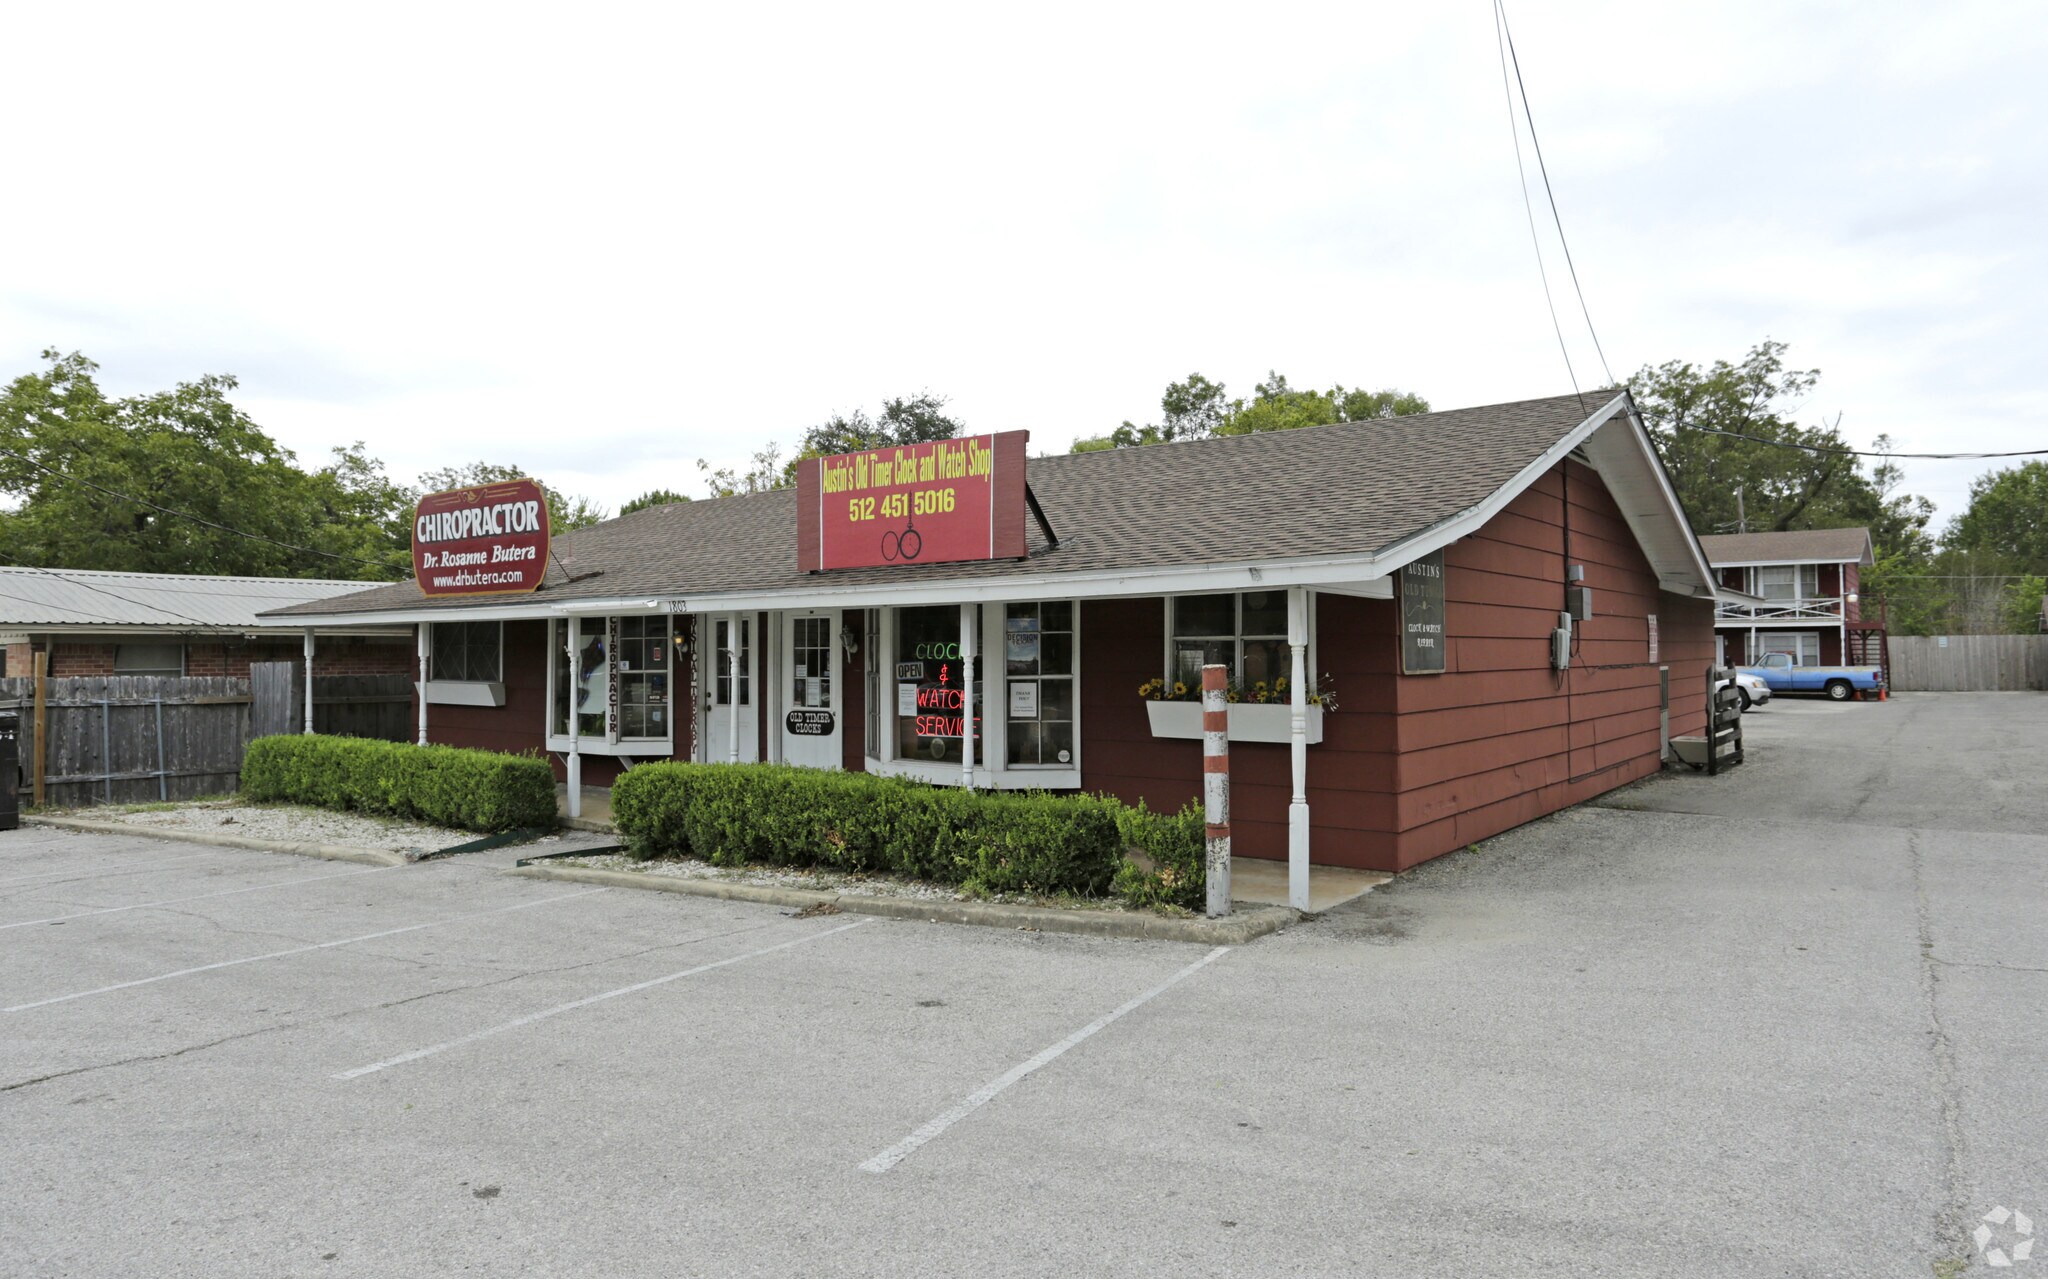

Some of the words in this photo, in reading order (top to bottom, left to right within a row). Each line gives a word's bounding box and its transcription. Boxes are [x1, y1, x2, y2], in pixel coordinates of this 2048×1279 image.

[823, 456, 854, 494] Austin's
[855, 454, 869, 490] Old
[870, 453, 893, 488] Timer
[894, 447, 918, 486] Clock
[920, 444, 936, 482] and
[937, 441, 967, 480] Watch
[968, 438, 991, 483] Shop
[849, 496, 876, 522] 512
[880, 492, 910, 519] 451
[914, 487, 956, 516] 5016
[416, 500, 540, 543] CHIROPRACTOR
[423, 552, 439, 569] Dr.
[440, 550, 488, 568] Rosanne
[491, 544, 536, 563] Butera
[433, 570, 523, 588] www.drbutera.com
[1407, 562, 1440, 579] AUSTIN'S
[669, 600, 687, 613] 1803
[609, 616, 617, 733] CHIROPRACTOR
[898, 664, 922, 678] OPEN
[790, 712, 803, 723] OLD
[805, 713, 831, 723] TIMER
[795, 723, 822, 734] CLOCKS
